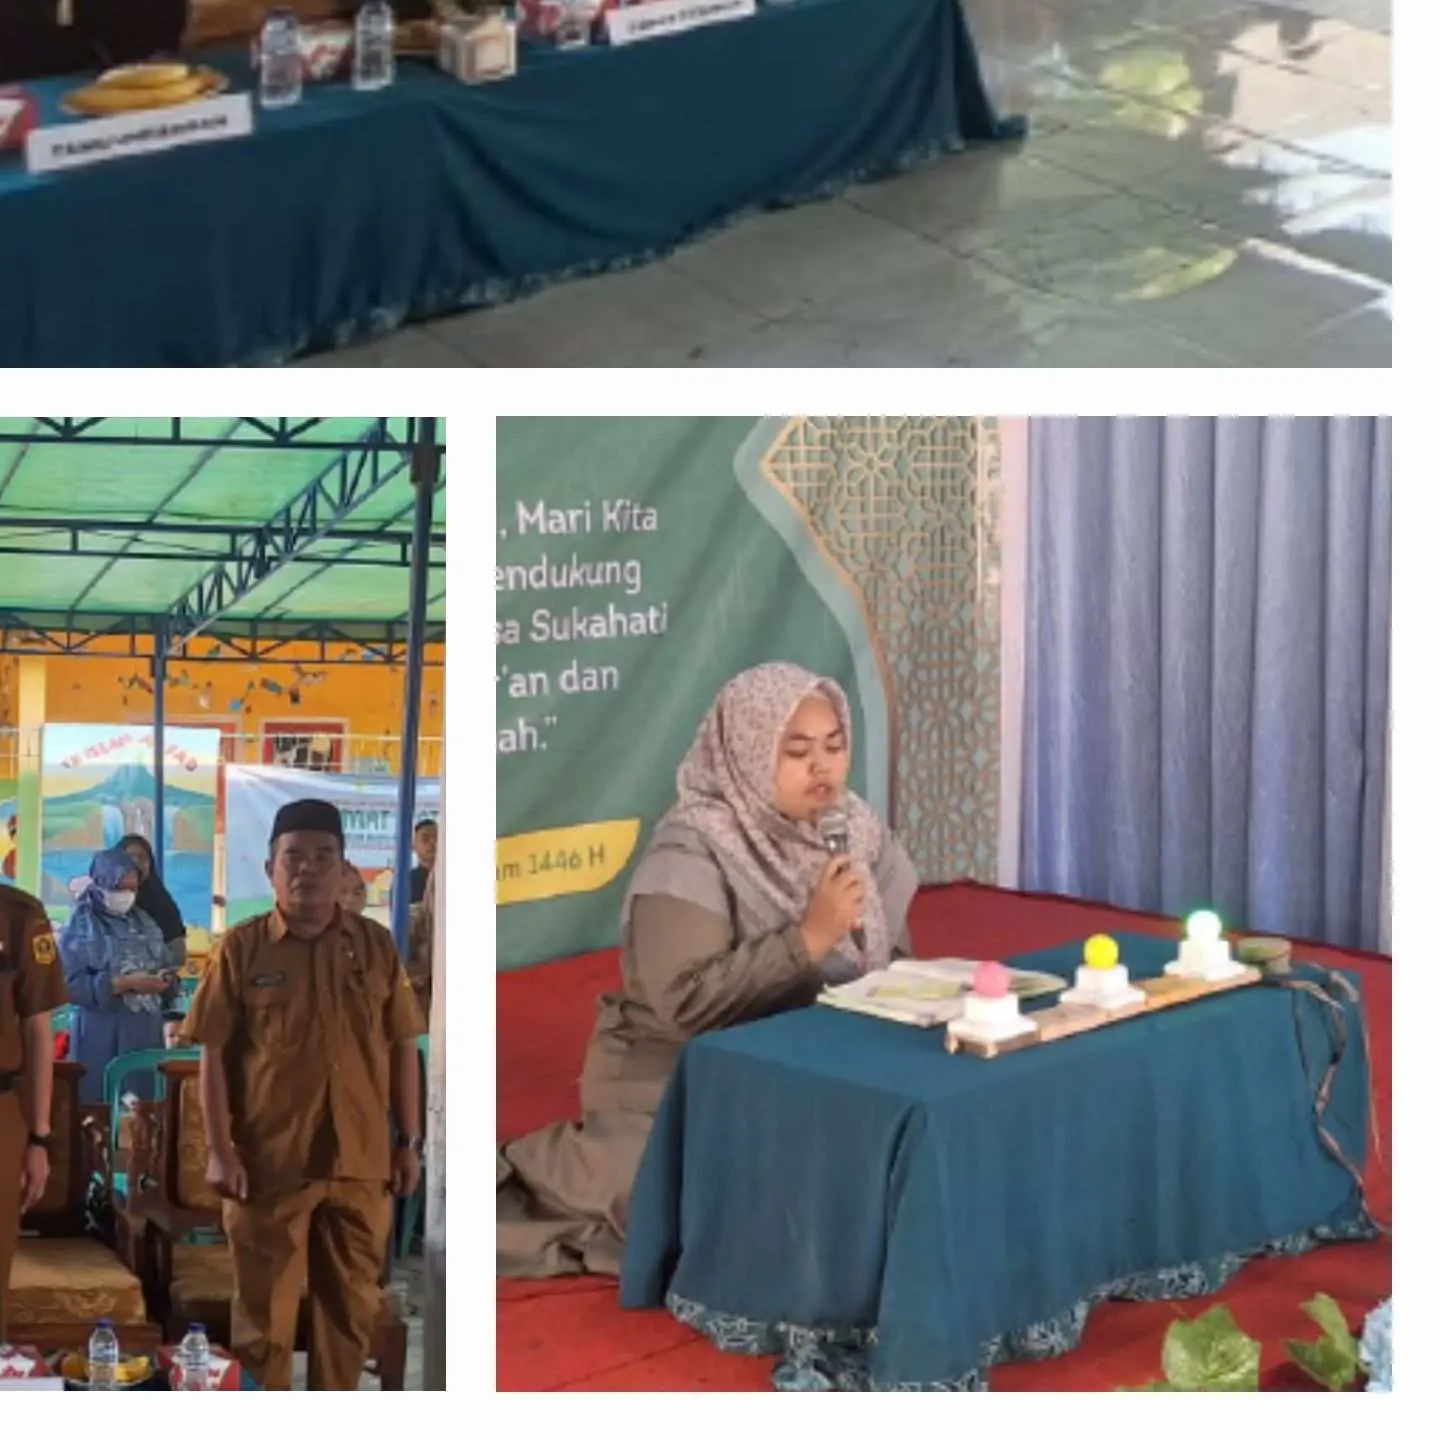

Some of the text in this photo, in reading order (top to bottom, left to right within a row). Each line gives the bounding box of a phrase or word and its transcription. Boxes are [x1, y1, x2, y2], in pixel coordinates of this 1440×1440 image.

[516, 498, 658, 535] Mari Kita
[530, 601, 667, 643] Sukahati
[559, 658, 618, 693] dan
[527, 850, 582, 875] 1446
[589, 842, 605, 867] H
